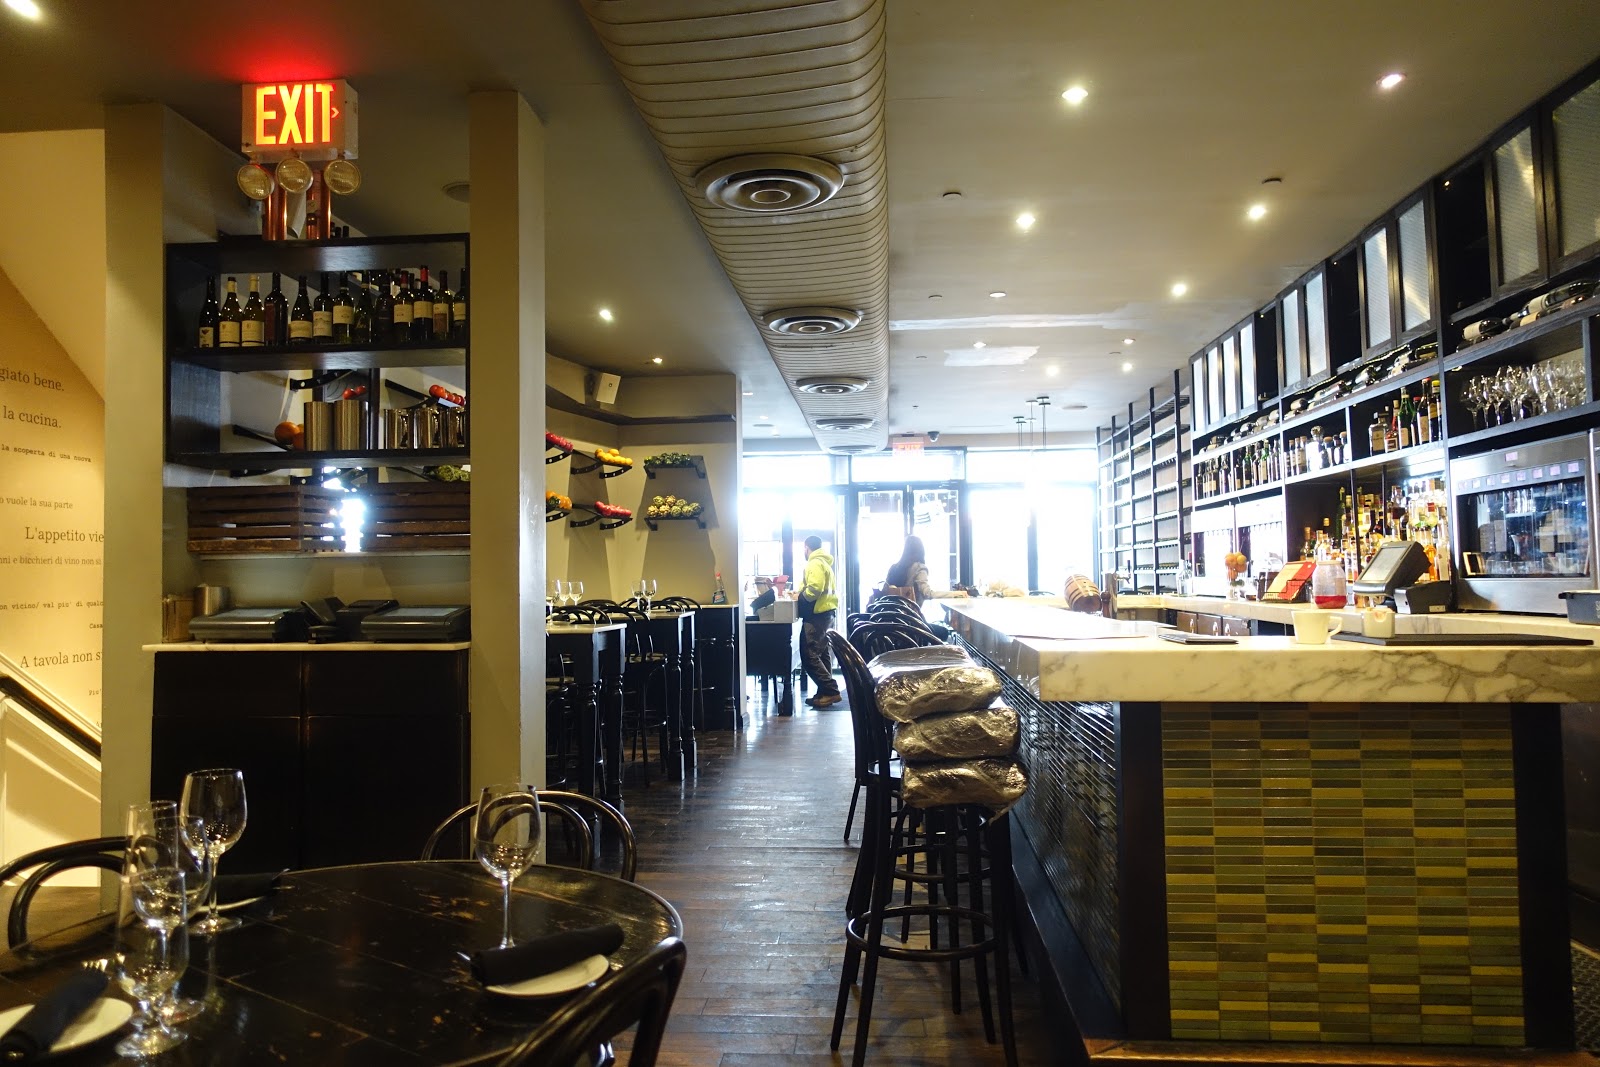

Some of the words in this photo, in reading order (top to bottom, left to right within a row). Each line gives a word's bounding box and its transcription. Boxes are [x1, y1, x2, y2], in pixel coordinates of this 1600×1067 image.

[255, 84, 334, 145] EXIT
[33, 372, 65, 392] bene.
[3, 405, 15, 420] la
[18, 411, 62, 429] cucina.
[1, 443, 10, 451] la
[13, 447, 45, 456] scoperta
[73, 455, 92, 463] nuova
[6, 496, 28, 506] vuole
[30, 498, 37, 507] la
[39, 500, 52, 508] sua
[54, 501, 74, 511] parte
[25, 526, 86, 544] L'appetito
[88, 531, 104, 543] vie
[19, 555, 53, 565] bicchieri
[54, 556, 63, 565] di
[64, 557, 80, 565] vino
[42, 601, 55, 609] val
[20, 655, 30, 669] A
[33, 651, 70, 668] tavola
[72, 652, 93, 664] non
